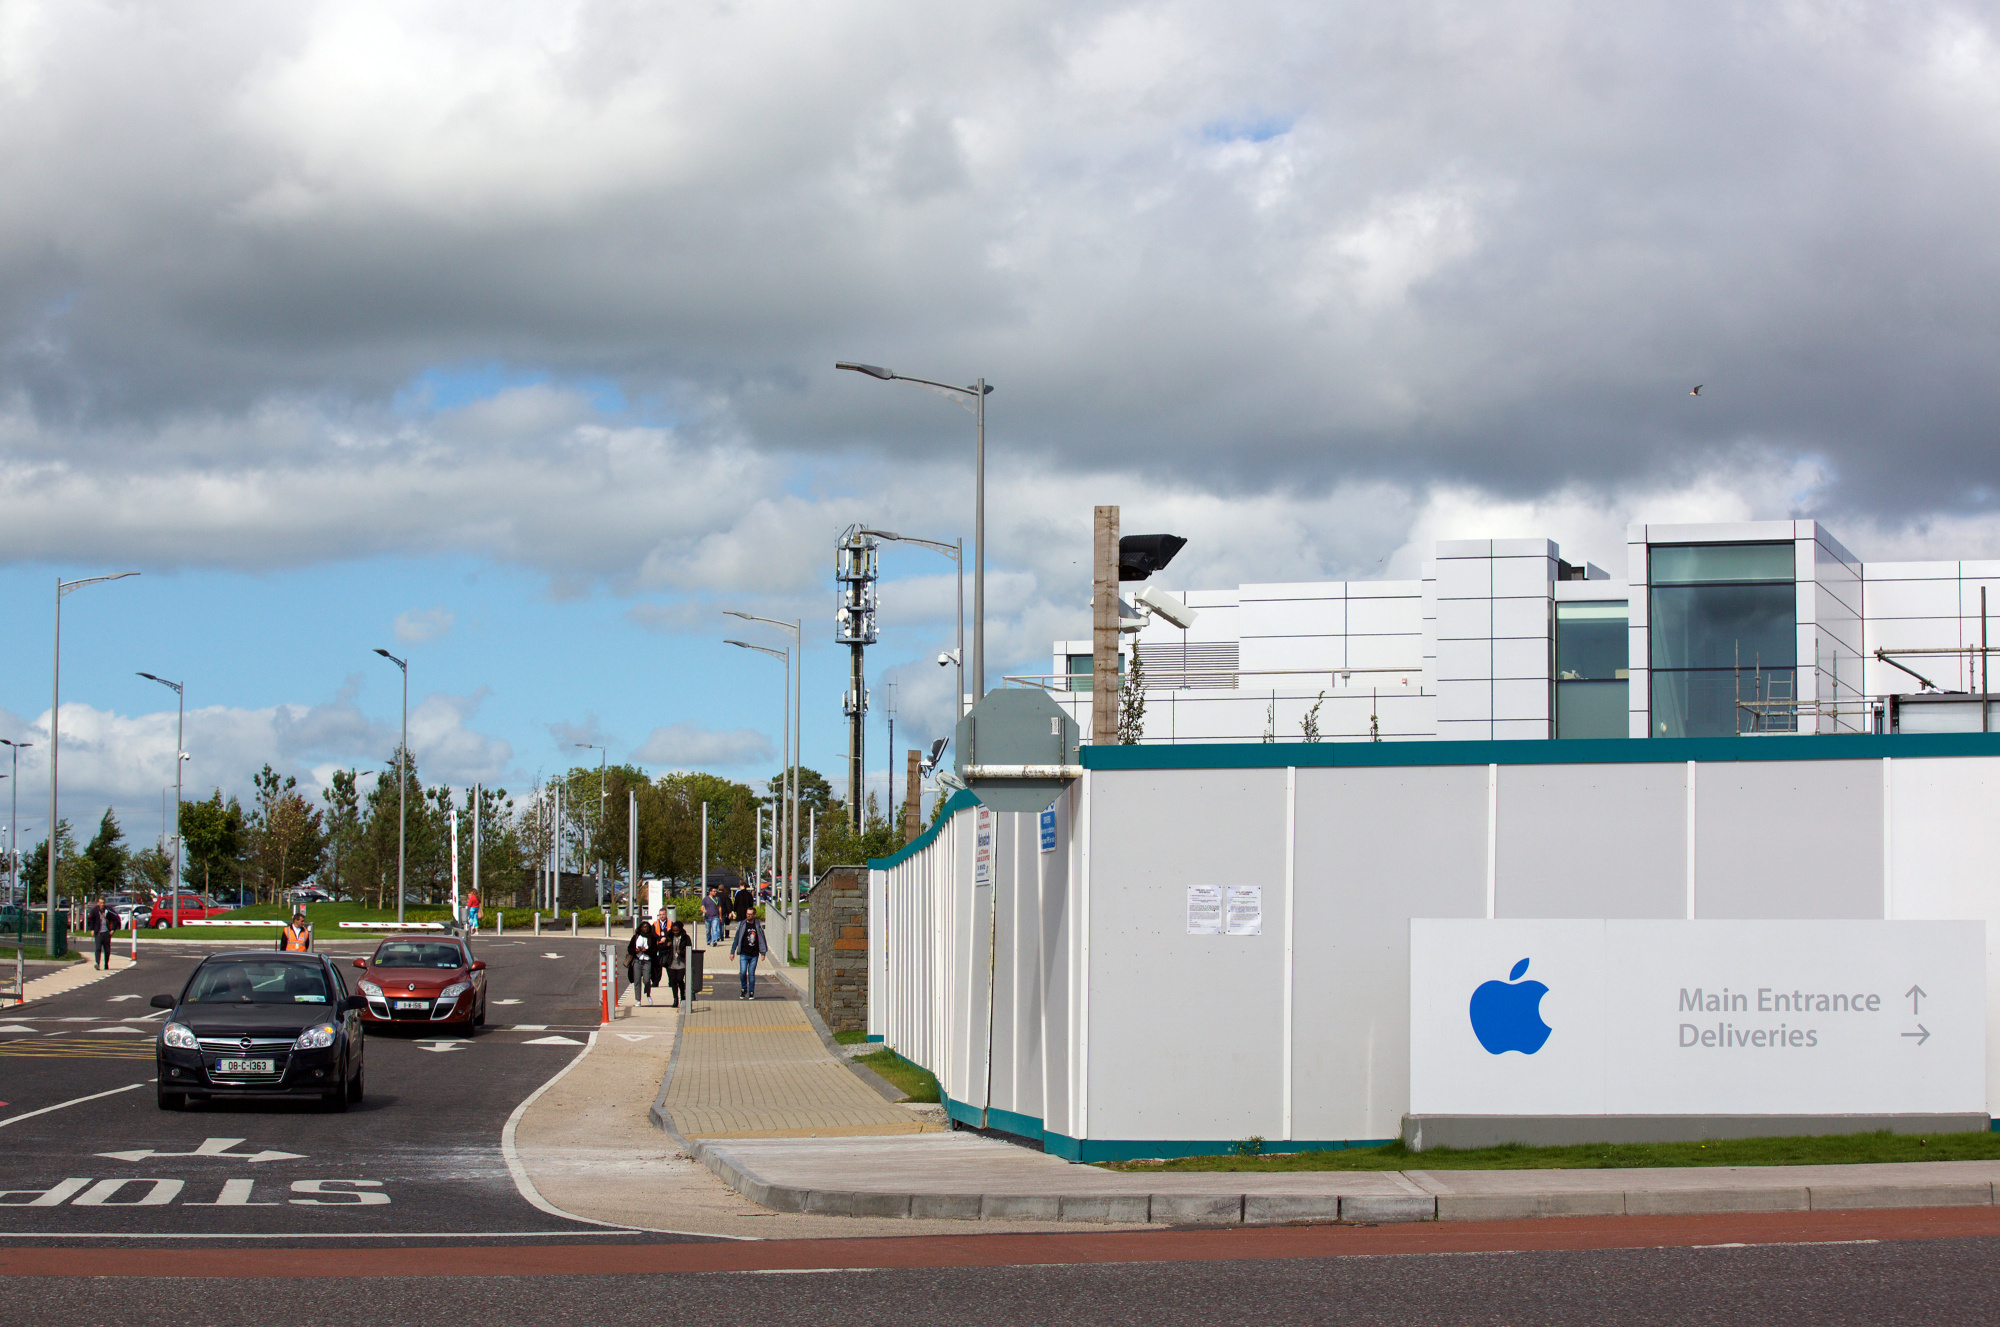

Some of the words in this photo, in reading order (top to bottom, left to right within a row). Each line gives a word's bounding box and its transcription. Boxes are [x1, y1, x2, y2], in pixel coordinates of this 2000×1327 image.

[1679, 988, 1748, 1012] Main
[1757, 988, 1881, 1012] Entrance
[1679, 1022, 1818, 1048] Deliveries
[228, 1061, 267, 1070] 08-C-1363
[0, 1178, 392, 1207] STOP
